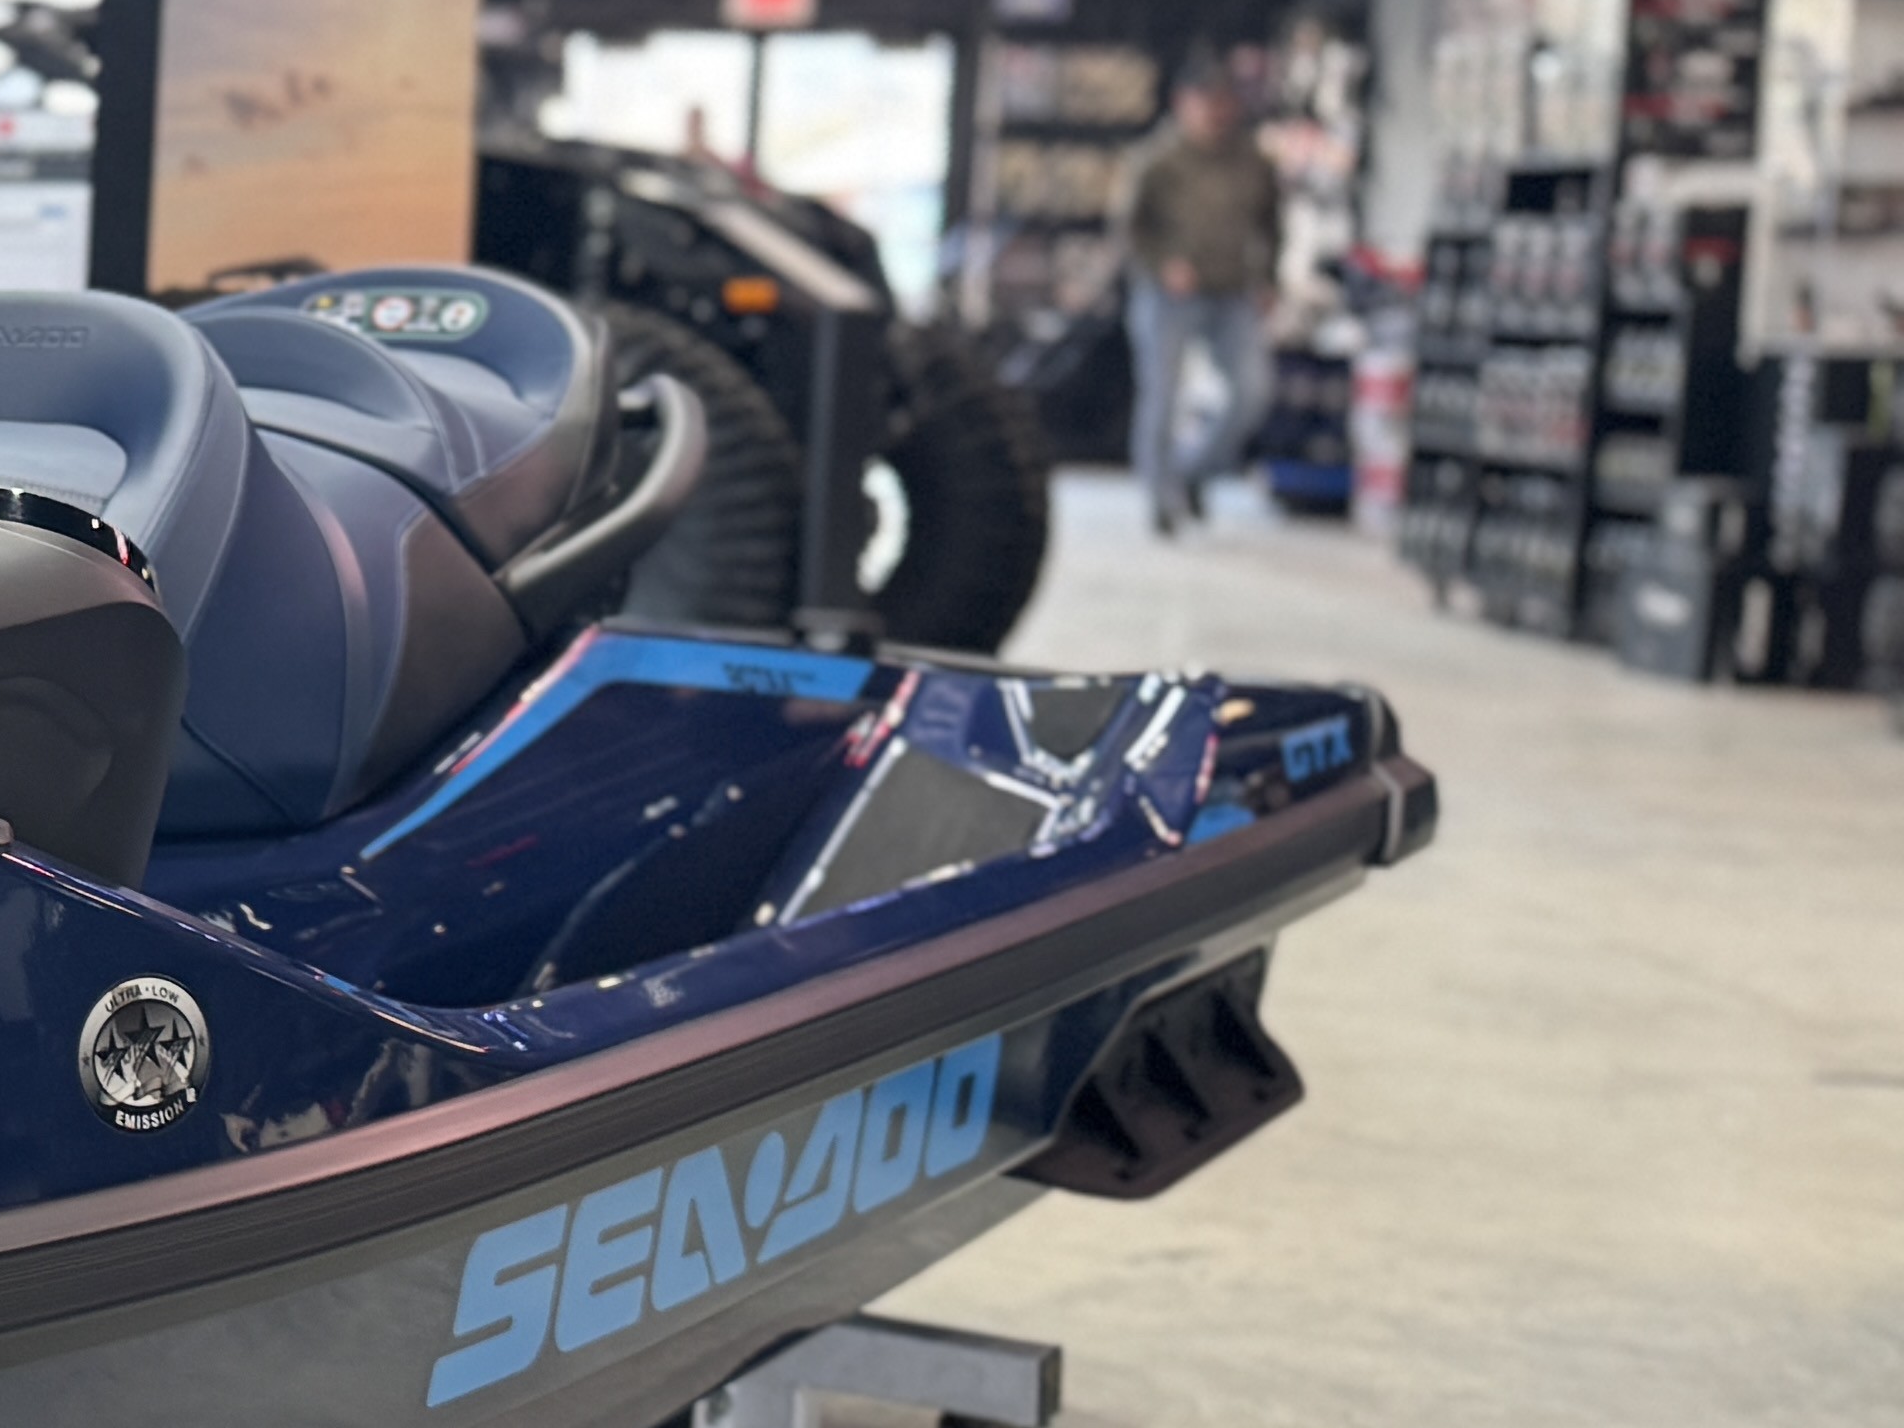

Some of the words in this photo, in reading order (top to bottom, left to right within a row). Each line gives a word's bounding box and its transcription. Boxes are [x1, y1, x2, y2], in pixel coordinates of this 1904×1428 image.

[105, 983, 143, 1013] ULTRA
[151, 985, 180, 1004] LOW
[115, 1099, 185, 1130] EMISSION
